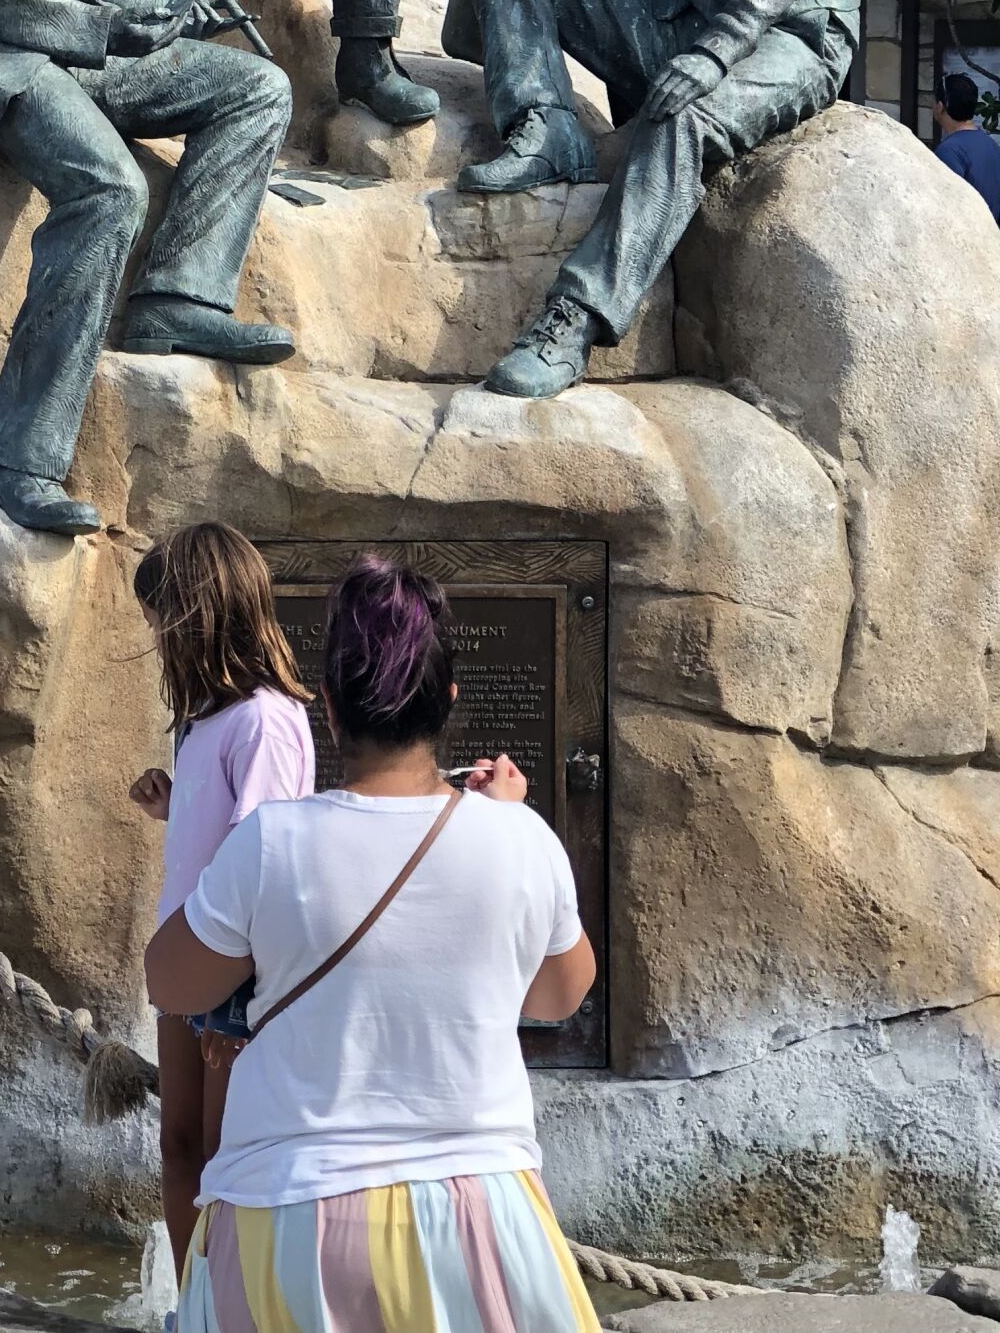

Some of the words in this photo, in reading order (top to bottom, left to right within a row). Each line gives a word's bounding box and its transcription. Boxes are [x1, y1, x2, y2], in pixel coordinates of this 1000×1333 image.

[446, 625, 507, 636] NUMENT
[529, 683, 546, 691] Row
[519, 702, 535, 710] and
